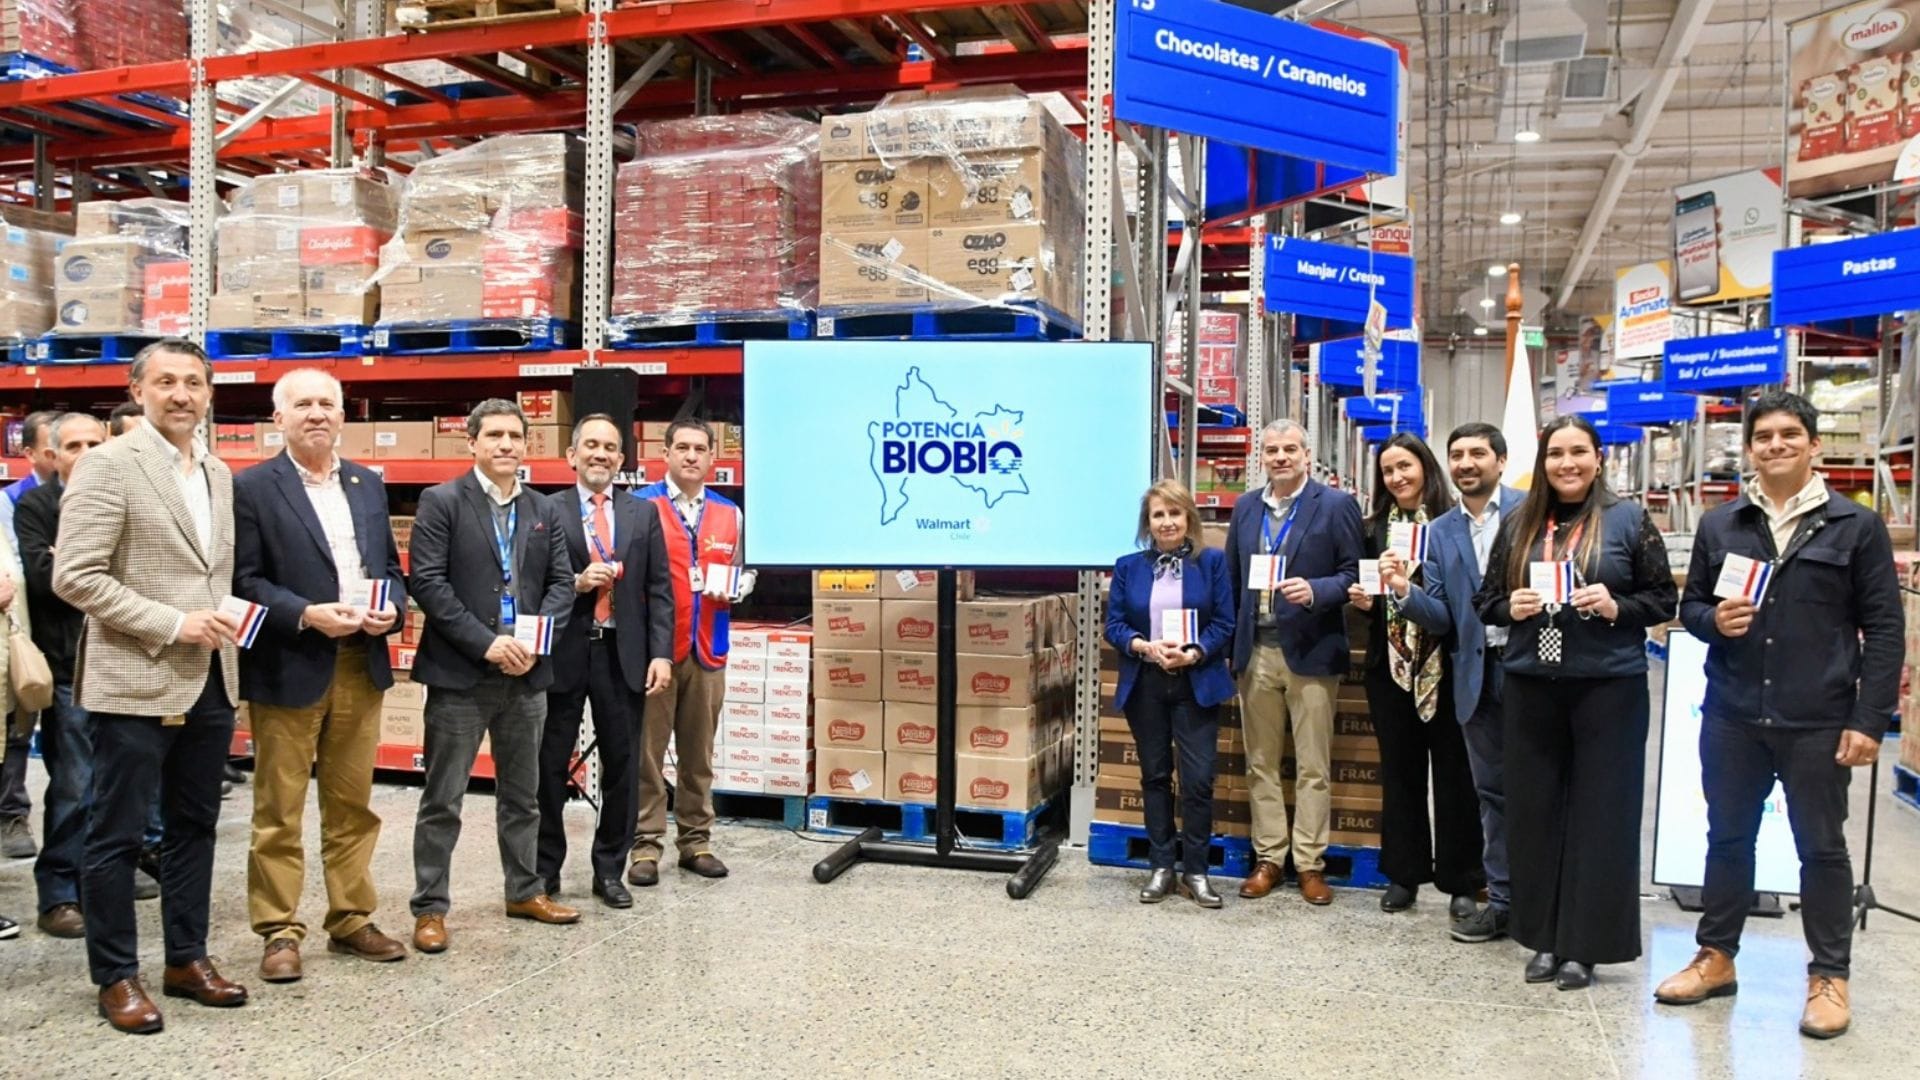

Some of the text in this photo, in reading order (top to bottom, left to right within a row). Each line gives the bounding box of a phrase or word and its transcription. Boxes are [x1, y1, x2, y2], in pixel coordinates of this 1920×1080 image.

[1851, 20, 1898, 41] malloa
[1155, 29, 1367, 97] Chocolates / Caramelos
[1271, 236, 1285, 250] 17
[967, 258, 999, 275] egg
[1297, 260, 1337, 281] Manjar
[1339, 266, 1347, 283] /
[1842, 256, 1897, 275] Pastas
[1669, 352, 1710, 365] Vinagres
[1701, 362, 1767, 377] Condimentos
[883, 422, 985, 438] POTENCIA
[883, 441, 1022, 474] BIOBIO
[916, 519, 971, 530] Walmart
[773, 665, 804, 673] TRENCITO
[729, 686, 758, 694] TRENCITO
[772, 689, 802, 697] TRENCITO
[729, 708, 758, 716] TRENCITO
[771, 711, 800, 719] TRENCITO
[729, 731, 758, 739] TRENCITO
[770, 734, 800, 742] TRENCITO
[730, 754, 759, 762] TRENCITO
[770, 757, 800, 765] TRENCITO
[730, 776, 758, 784] TRENCITO
[1338, 768, 1376, 781] FRAC
[1119, 796, 1144, 809] FRA
[1337, 816, 1374, 830] FRAC
